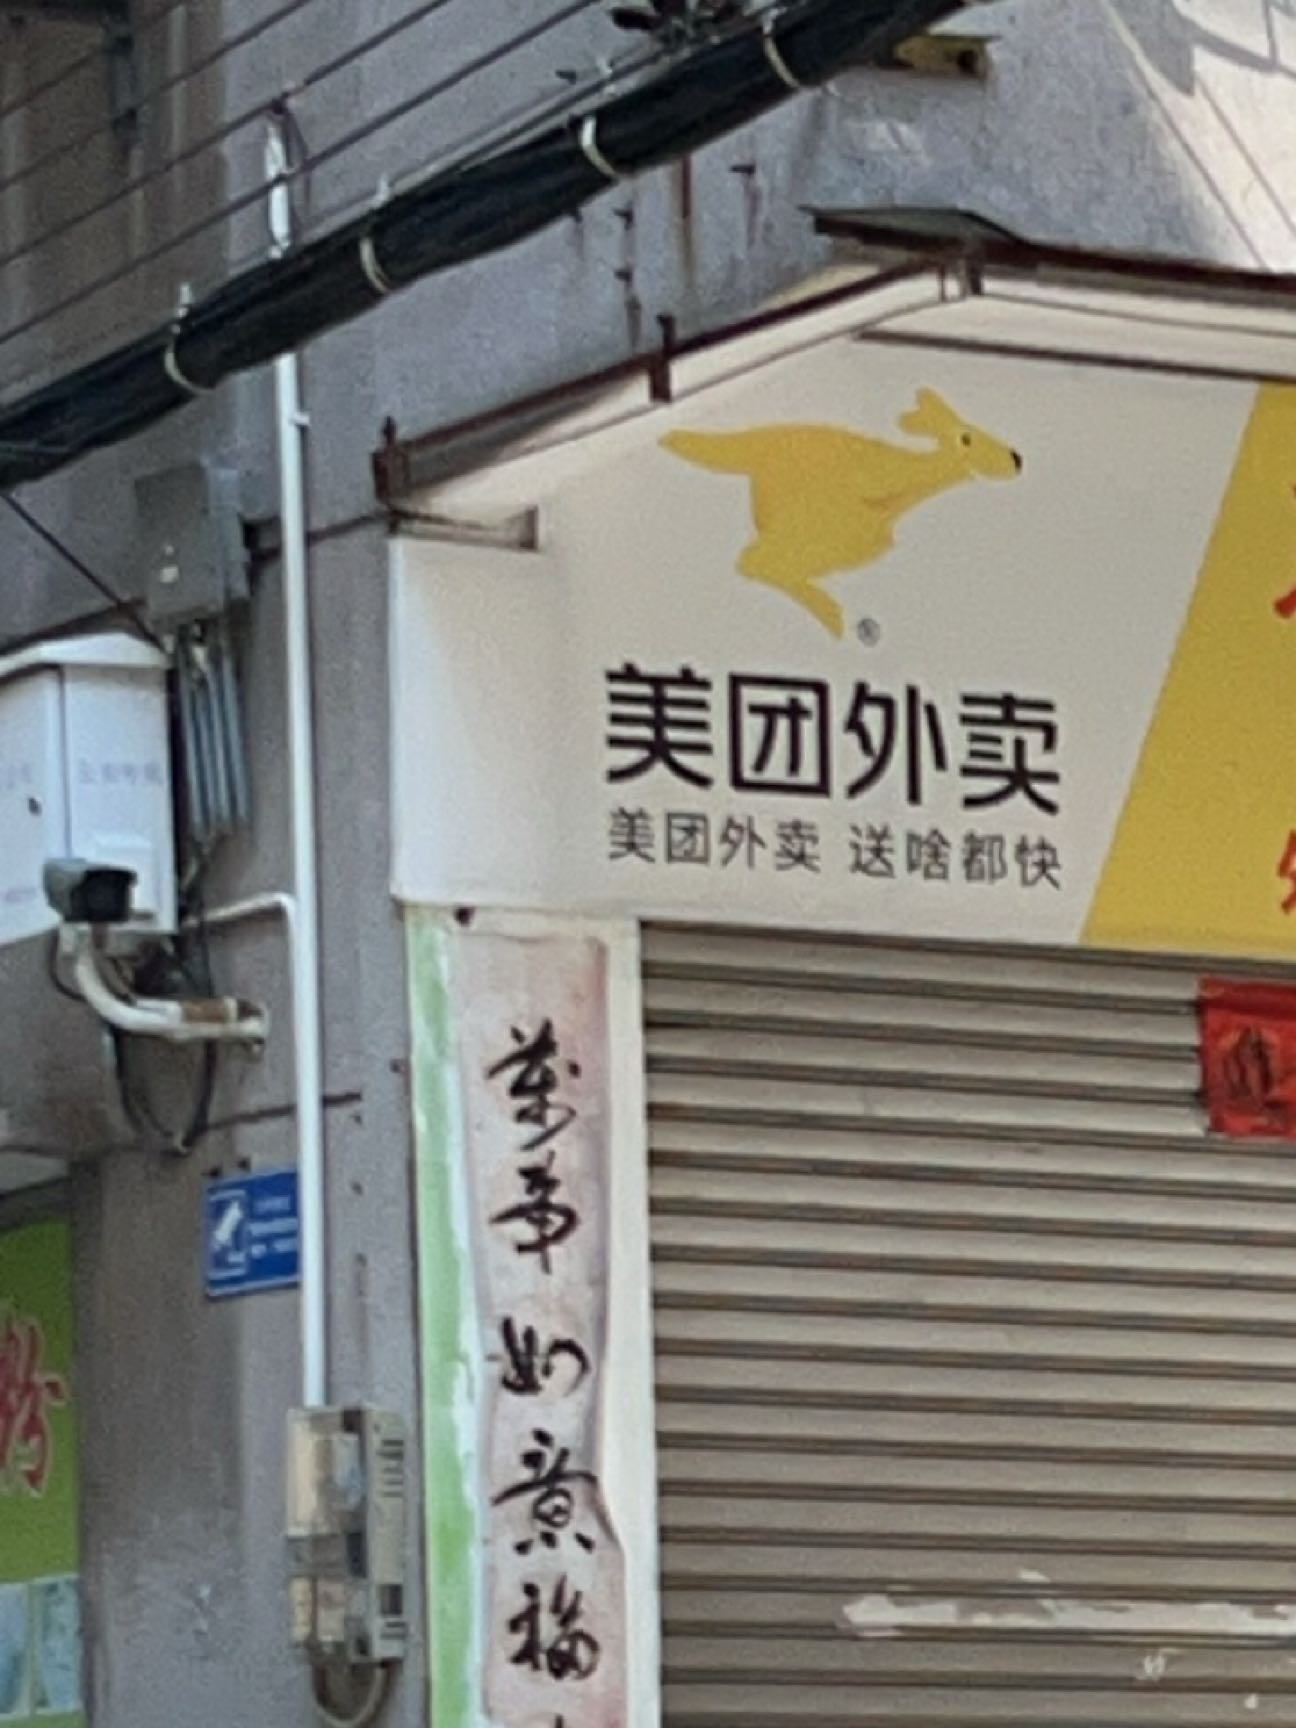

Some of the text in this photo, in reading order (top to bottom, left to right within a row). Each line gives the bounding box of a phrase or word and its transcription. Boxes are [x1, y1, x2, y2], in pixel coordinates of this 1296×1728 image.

[604, 662, 1061, 816] 美团外卖
[608, 807, 1062, 890] 美团外卖 送啥都快
